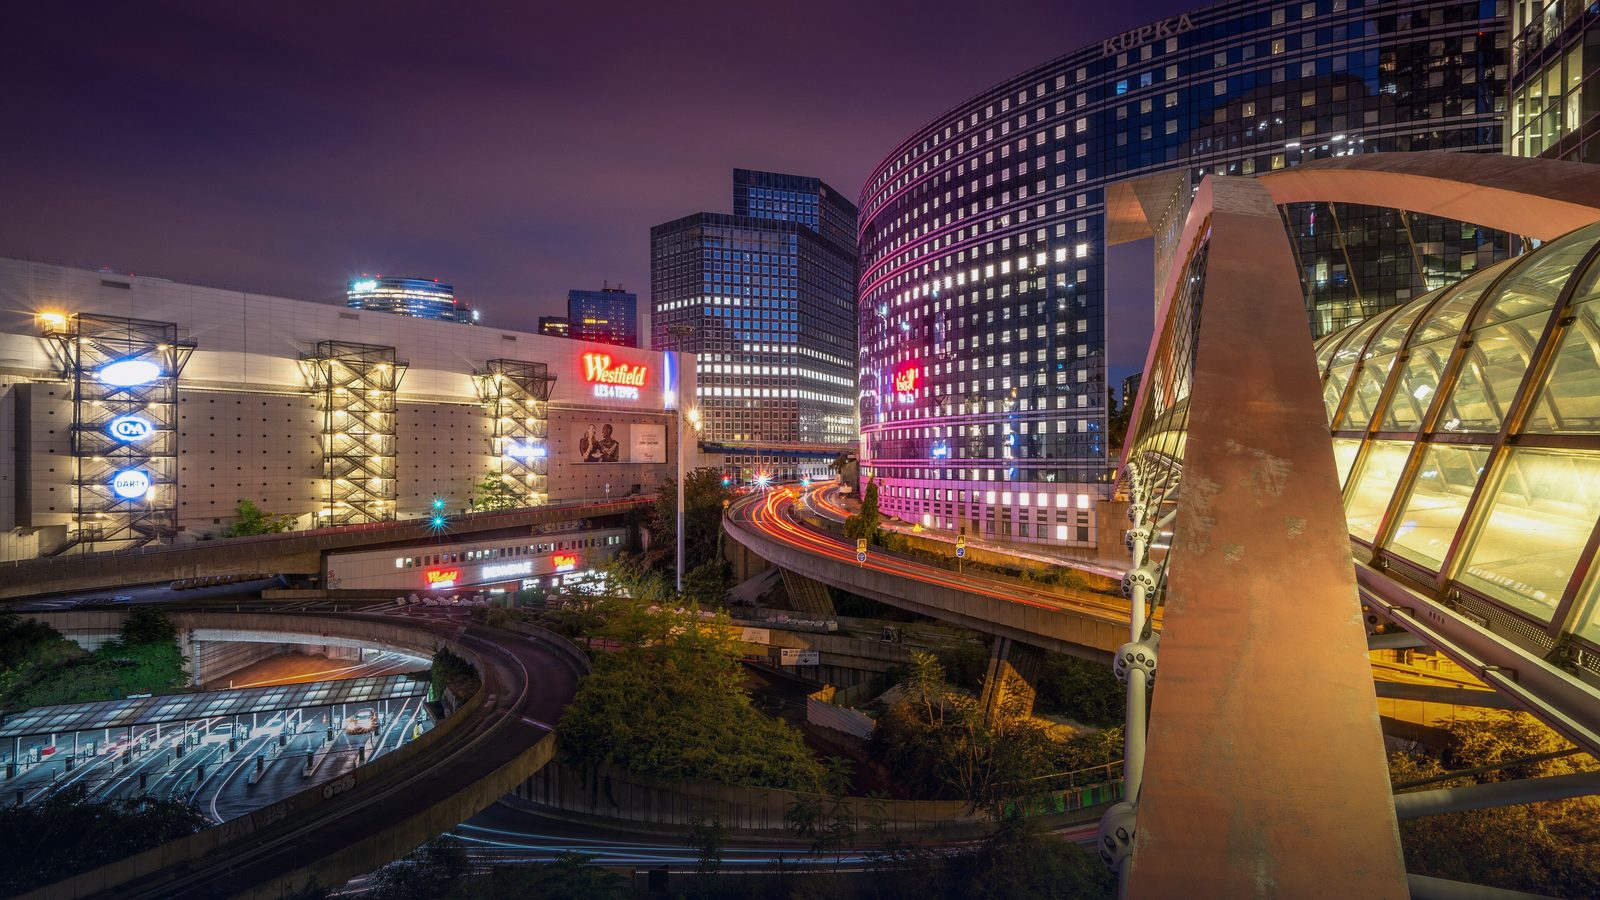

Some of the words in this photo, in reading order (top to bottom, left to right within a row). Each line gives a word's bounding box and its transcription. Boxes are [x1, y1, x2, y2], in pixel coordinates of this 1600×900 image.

[1102, 14, 1195, 57] KUPKA
[583, 353, 647, 386] Westfield
[594, 384, 609, 397] LES
